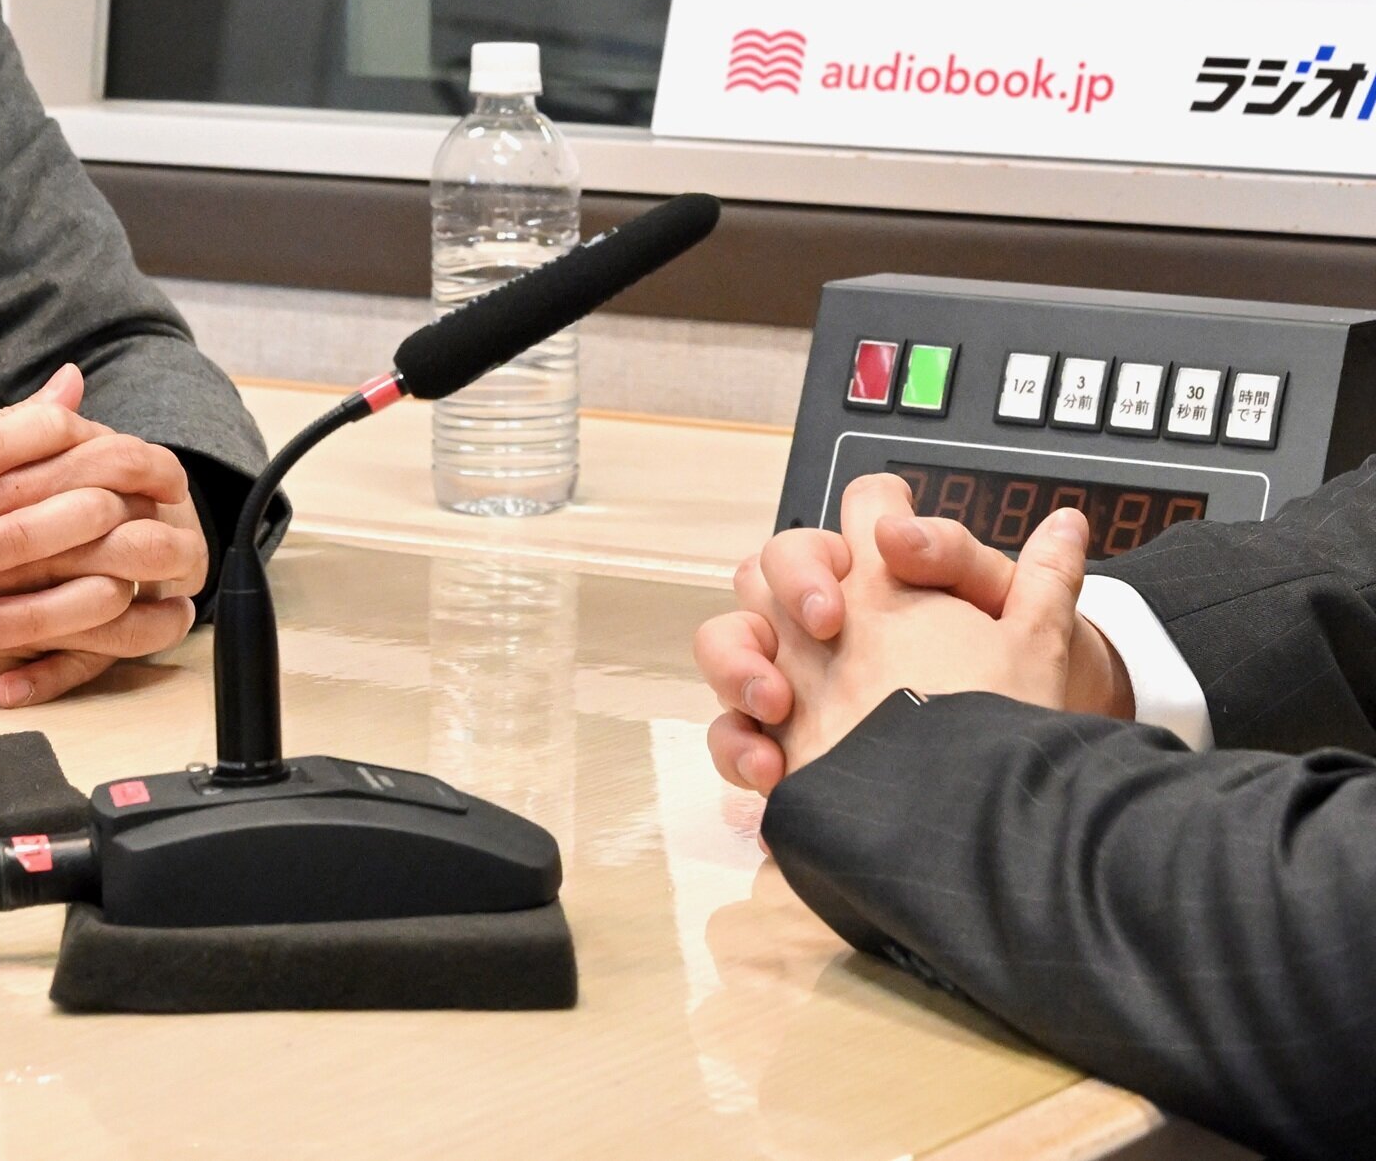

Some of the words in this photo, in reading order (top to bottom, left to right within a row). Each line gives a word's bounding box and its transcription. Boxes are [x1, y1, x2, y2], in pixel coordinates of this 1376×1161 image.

[821, 51, 1115, 114] audiobook.jp
[1014, 378, 1036, 394] 1/2
[1076, 376, 1086, 389] 3
[1186, 385, 1205, 400] 30
[1239, 390, 1270, 407] 時間
[1063, 393, 1093, 410] 分前
[1119, 398, 1150, 416] 分前
[1176, 404, 1207, 421] 秒前
[1237, 407, 1267, 424] です
